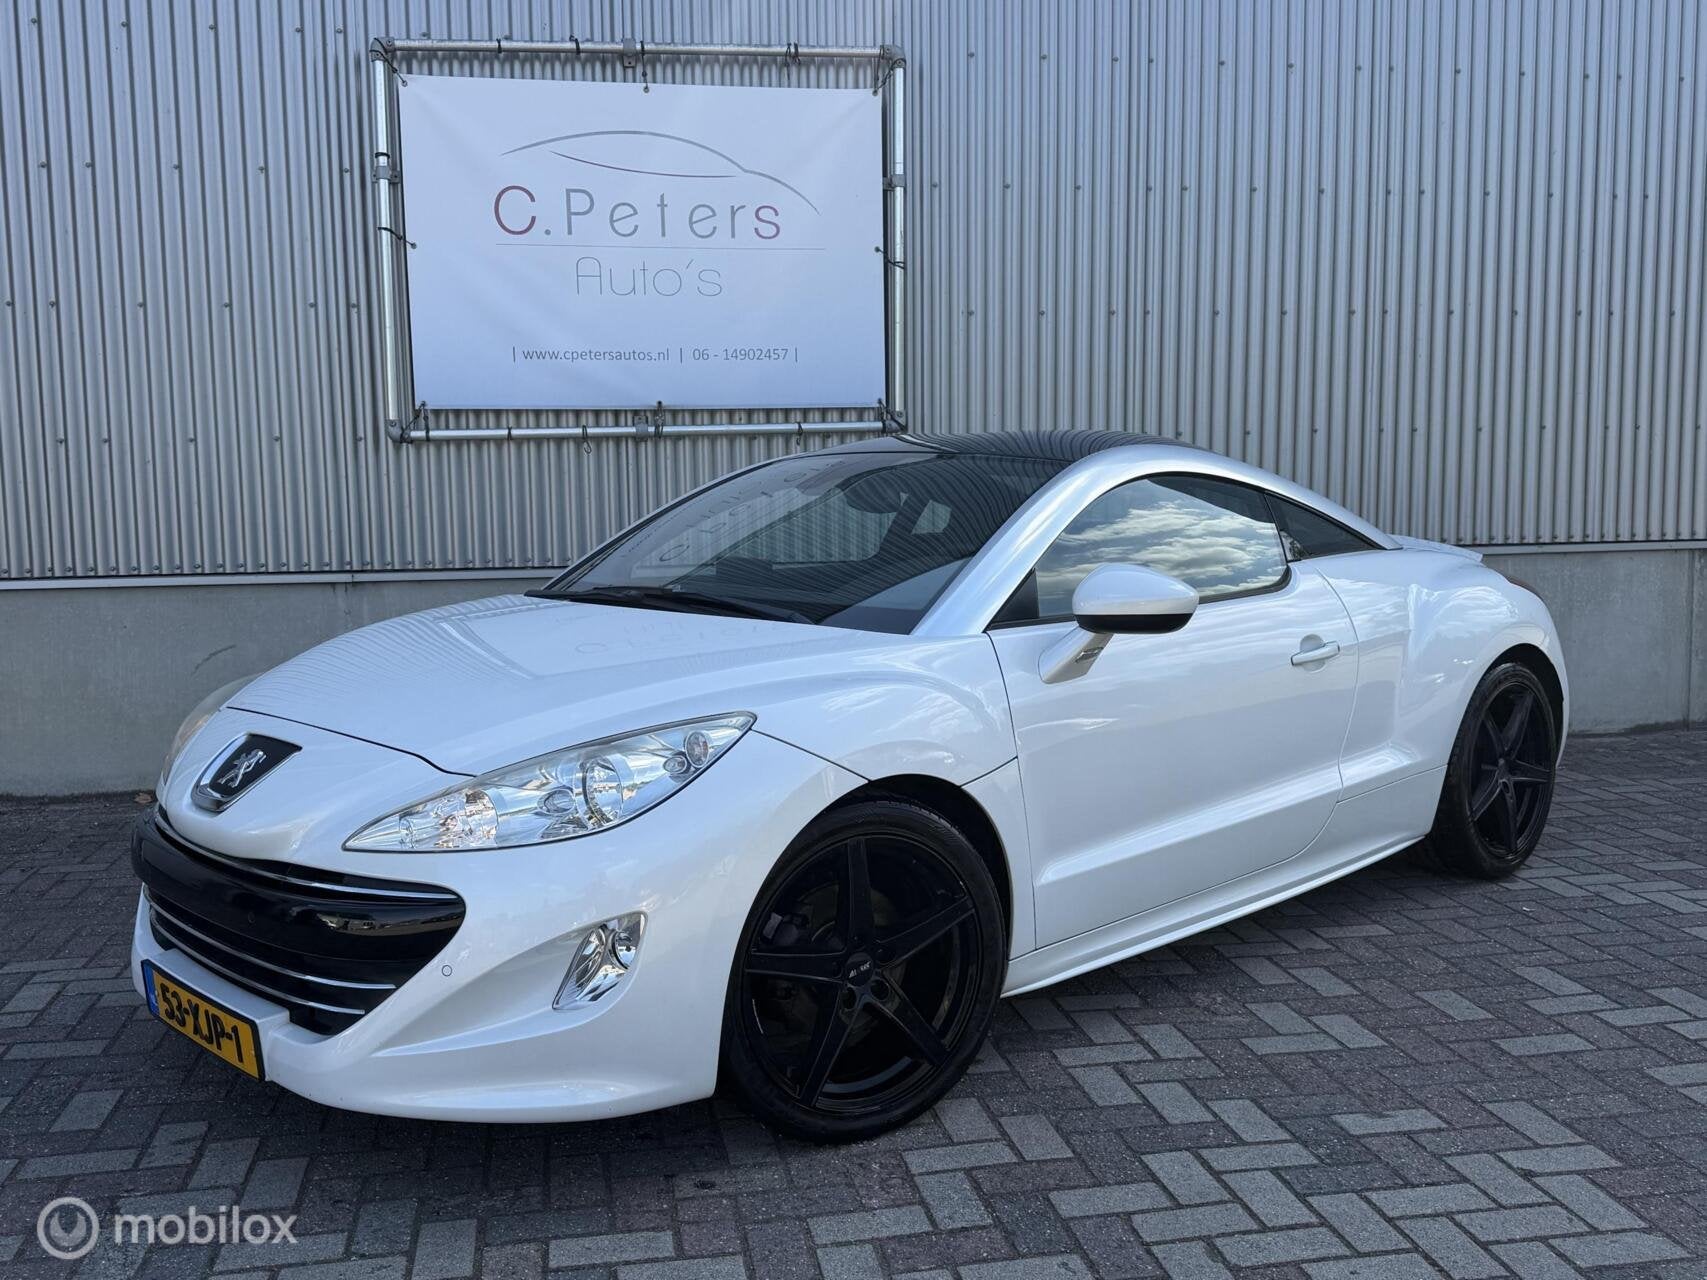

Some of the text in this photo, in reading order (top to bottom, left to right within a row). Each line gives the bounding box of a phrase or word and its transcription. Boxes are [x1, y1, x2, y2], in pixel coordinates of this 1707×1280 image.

[493, 184, 782, 240] C.Peters
[522, 347, 670, 363] www.cpetersautos.nl
[692, 347, 710, 361] 06
[723, 347, 789, 361] 14902457
[159, 982, 244, 1063] 53-XJP-1
